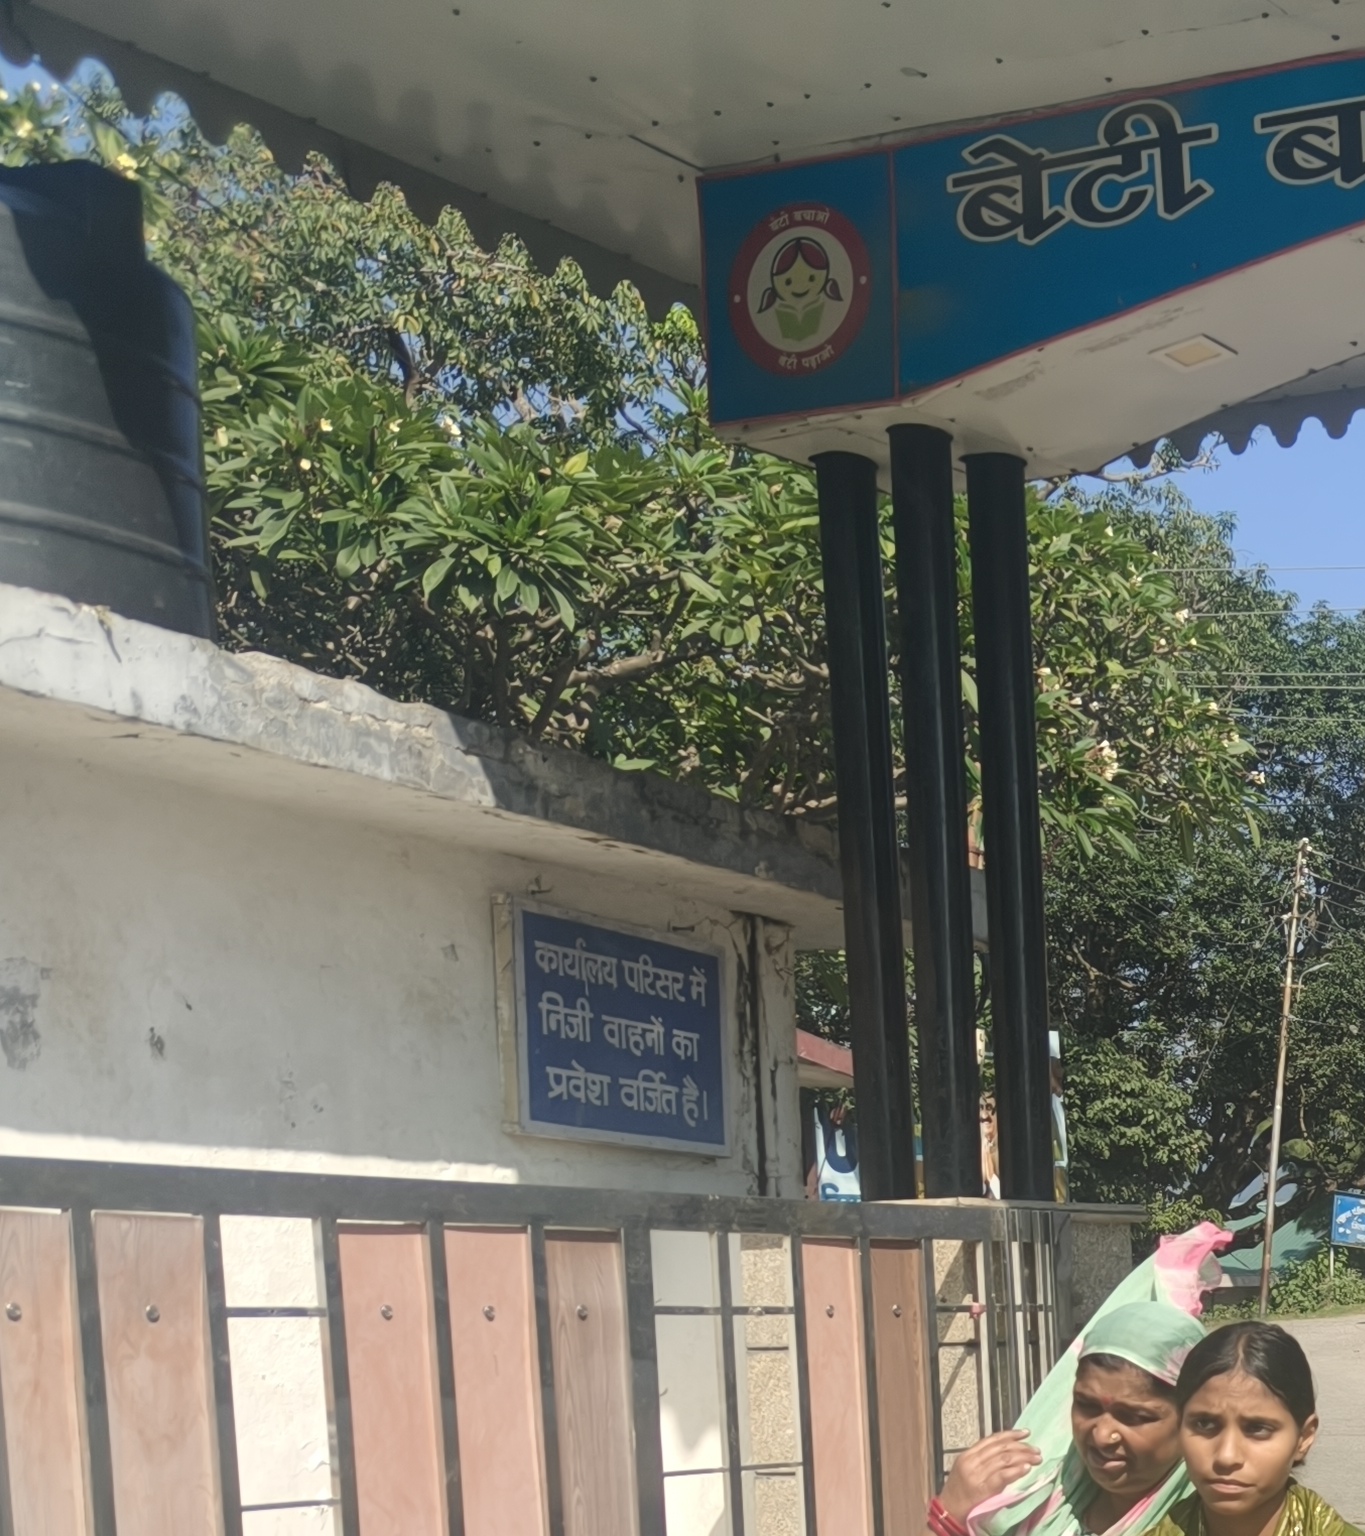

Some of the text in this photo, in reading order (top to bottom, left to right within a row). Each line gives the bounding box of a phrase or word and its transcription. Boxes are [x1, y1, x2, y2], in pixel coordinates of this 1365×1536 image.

[947, 99, 1219, 246] बेटी
[534, 938, 706, 1007] कार्यालय परिसर में
[538, 991, 699, 1062] निजी वाहनों का
[546, 1060, 611, 1106] प्रवेश
[619, 1069, 679, 1115] वर्जित
